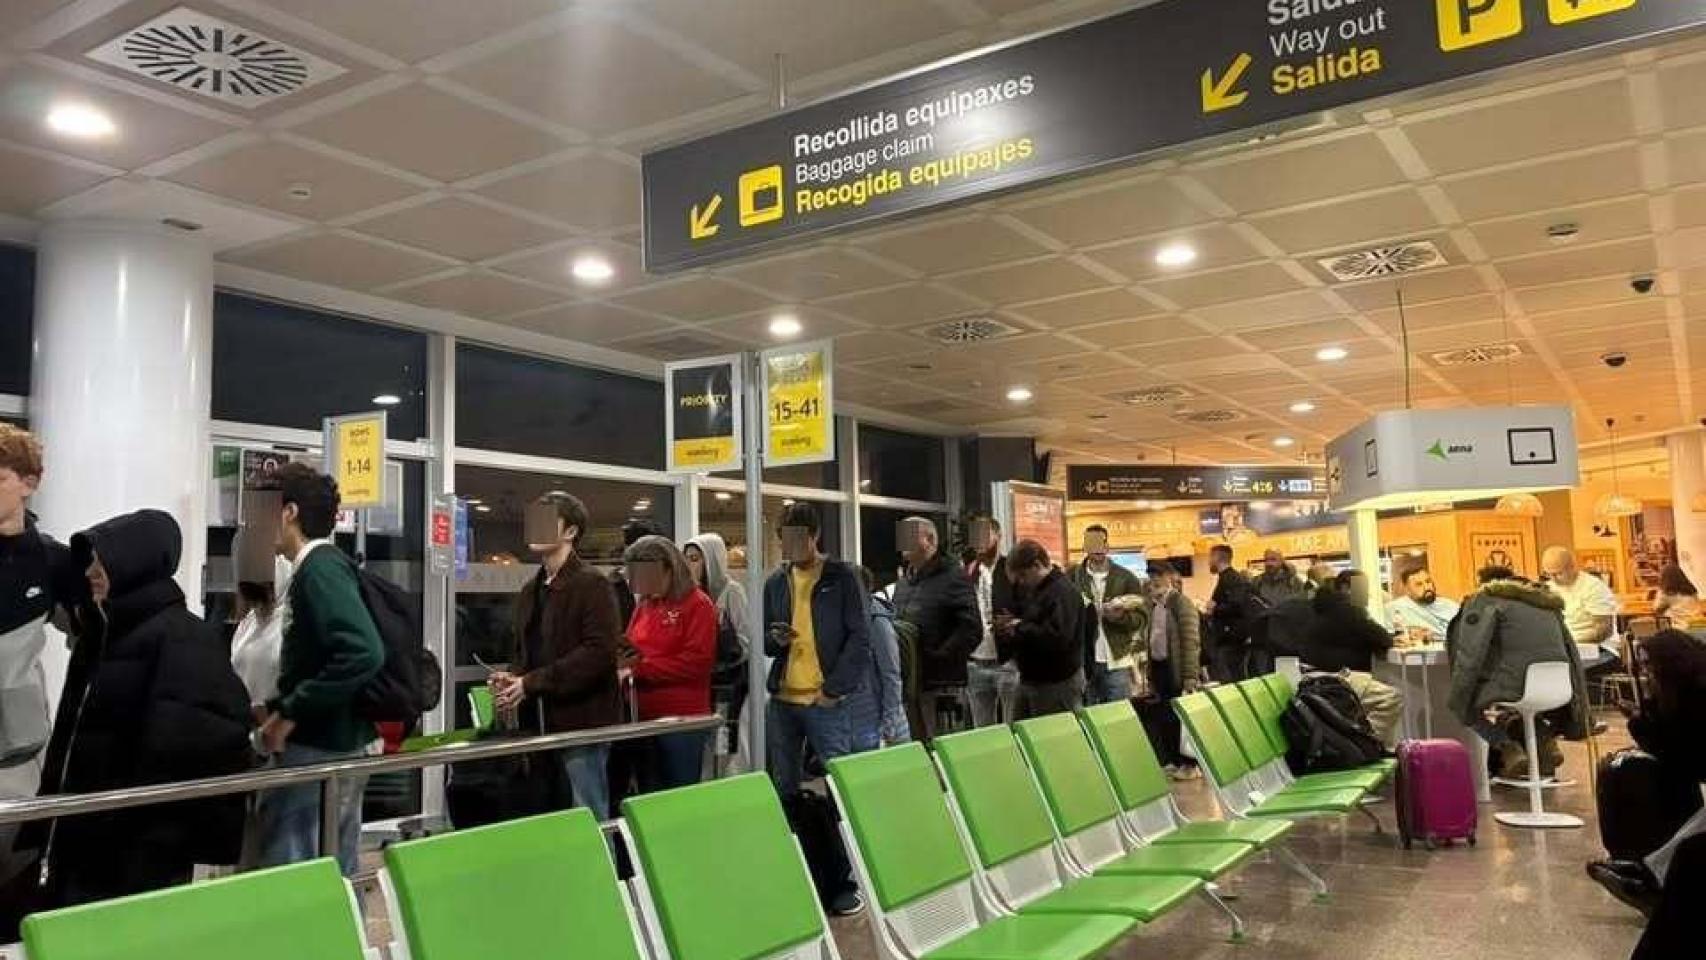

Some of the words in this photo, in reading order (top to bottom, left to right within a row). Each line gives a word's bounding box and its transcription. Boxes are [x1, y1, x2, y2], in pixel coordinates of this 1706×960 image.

[1268, 25, 1331, 58] Way
[1338, 6, 1387, 40] out
[1271, 47, 1381, 95] Salida
[794, 111, 899, 158] Recollida
[904, 74, 1035, 127] equipaxes
[795, 148, 878, 184] Baggage
[882, 133, 935, 162] claim
[796, 168, 903, 214] Recogida
[908, 137, 1034, 186] equipajes
[774, 396, 819, 422] 15-41
[346, 457, 371, 476] 1-14
